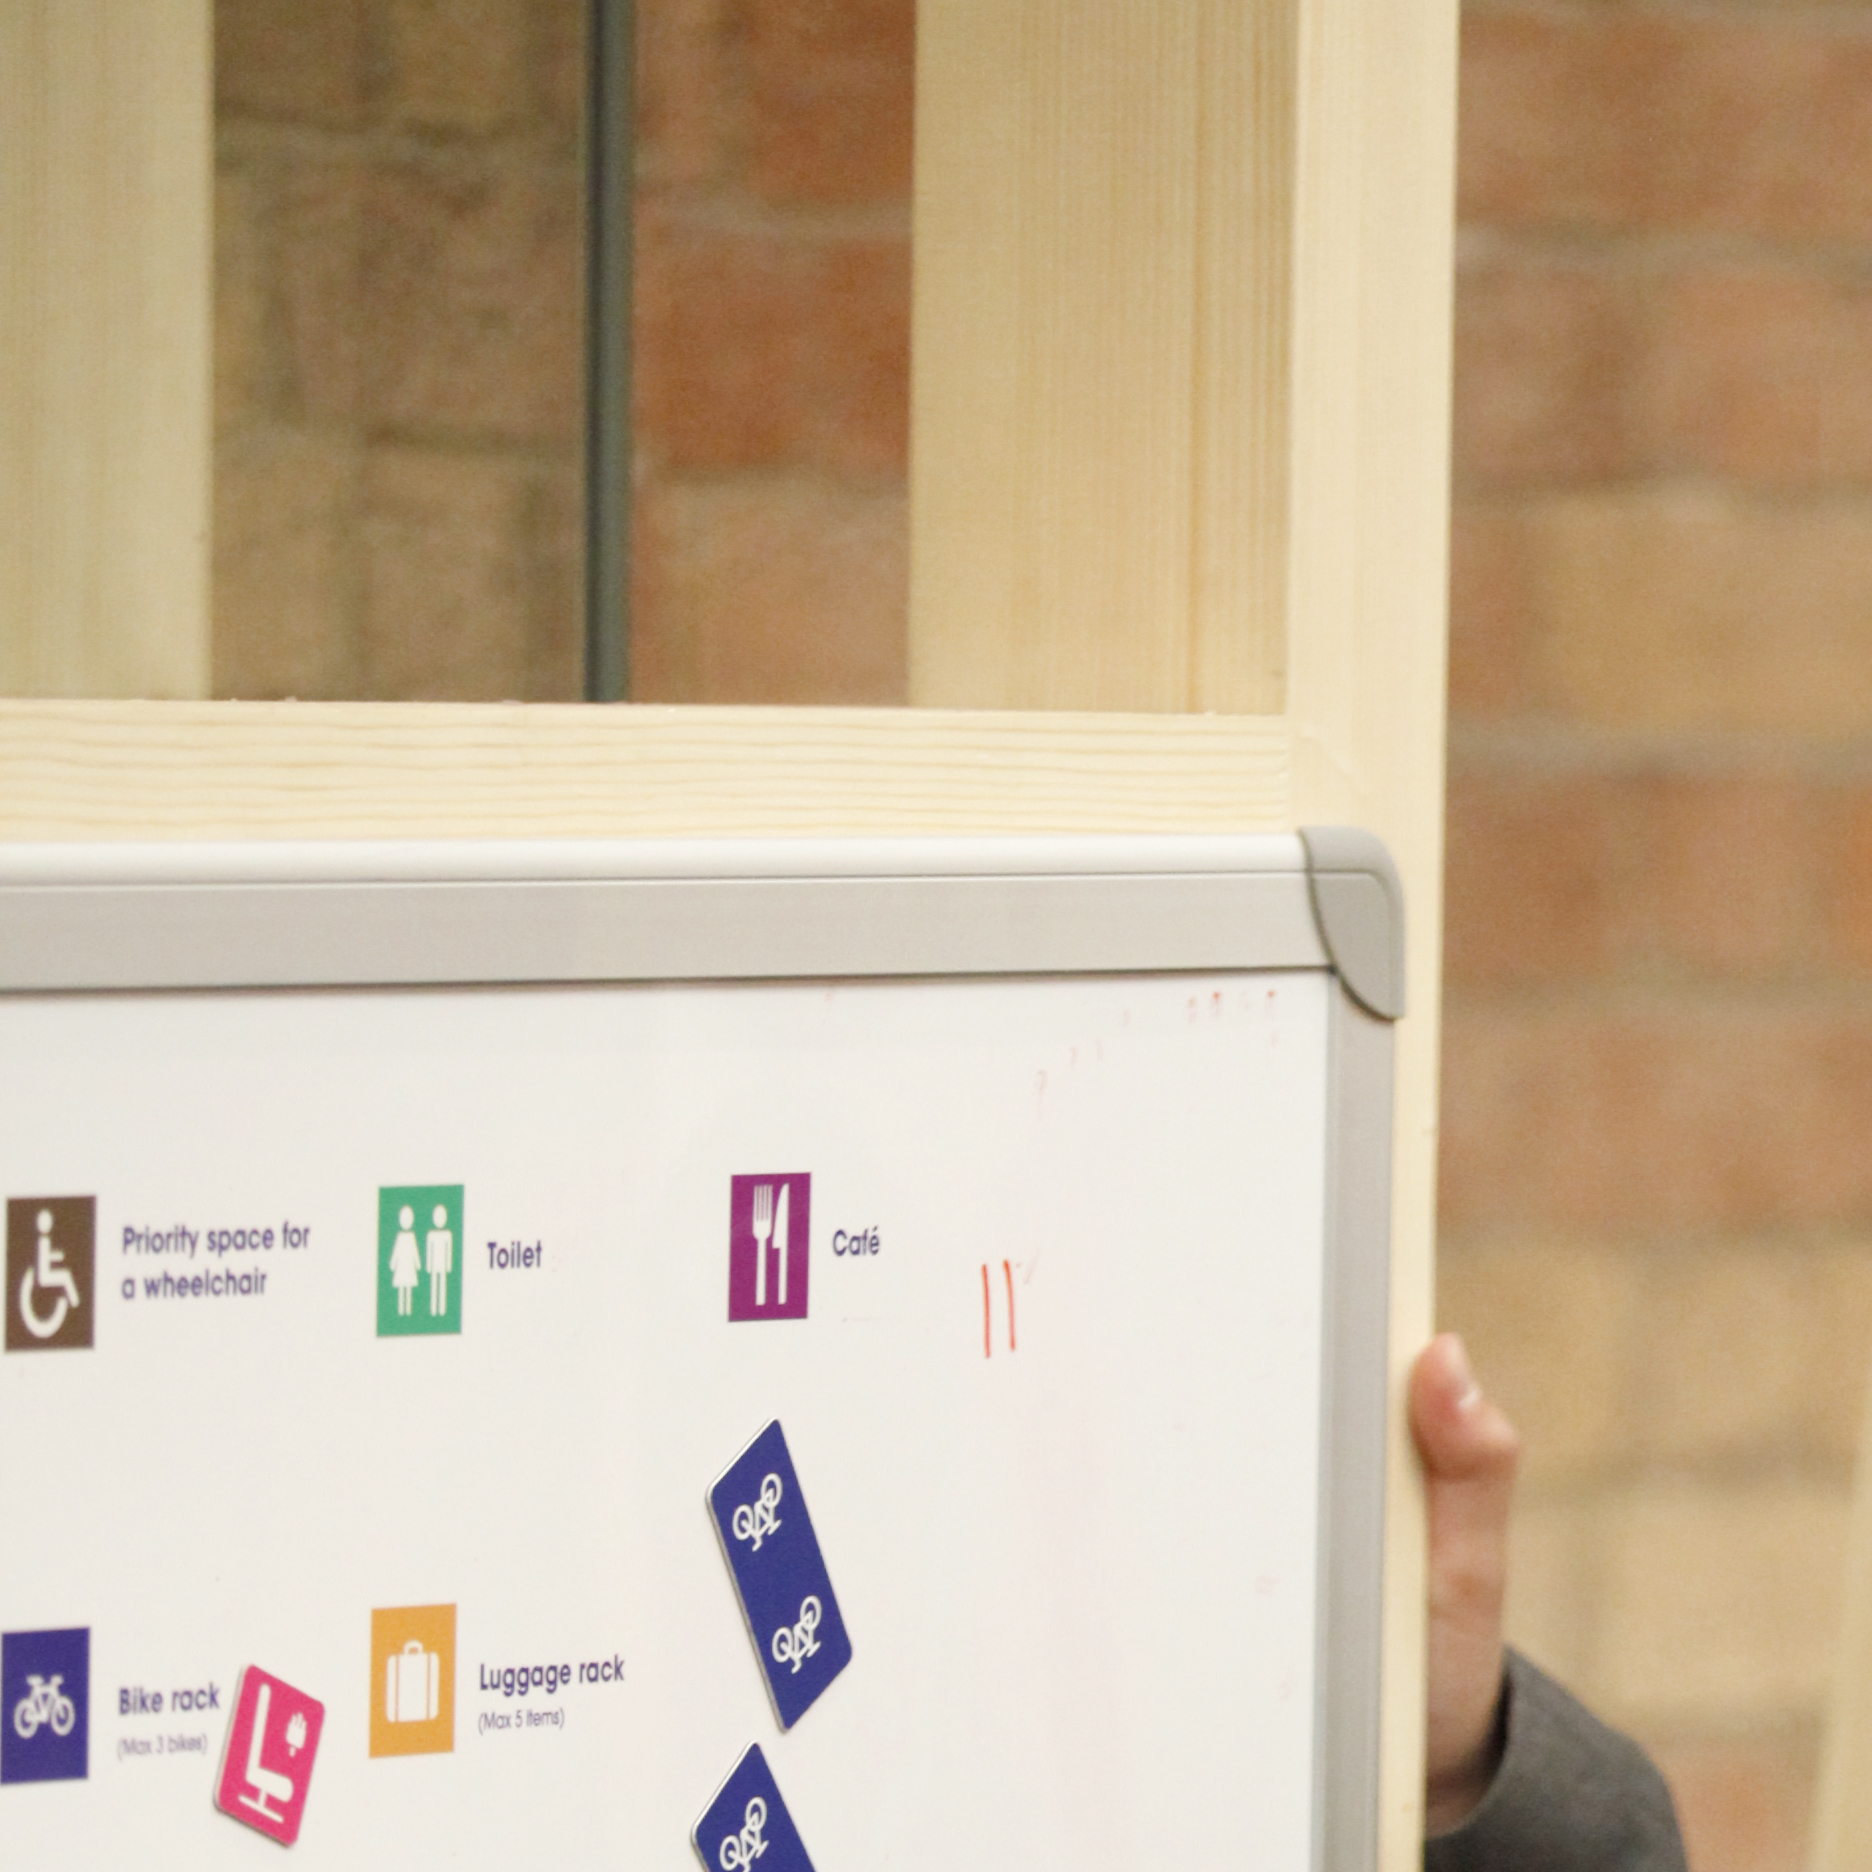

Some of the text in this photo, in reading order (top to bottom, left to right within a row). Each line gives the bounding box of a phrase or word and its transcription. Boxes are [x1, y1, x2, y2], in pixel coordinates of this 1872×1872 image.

[123, 1219, 310, 1259] Priority space for
[487, 1239, 543, 1269] Toilet
[832, 1225, 880, 1256] Café
[122, 1266, 268, 1300] a wheelchair
[480, 1654, 625, 1697] Luggage rack
[119, 1681, 220, 1715] Bike rack
[478, 1710, 512, 1735] (Max
[526, 1706, 565, 1730] items)
